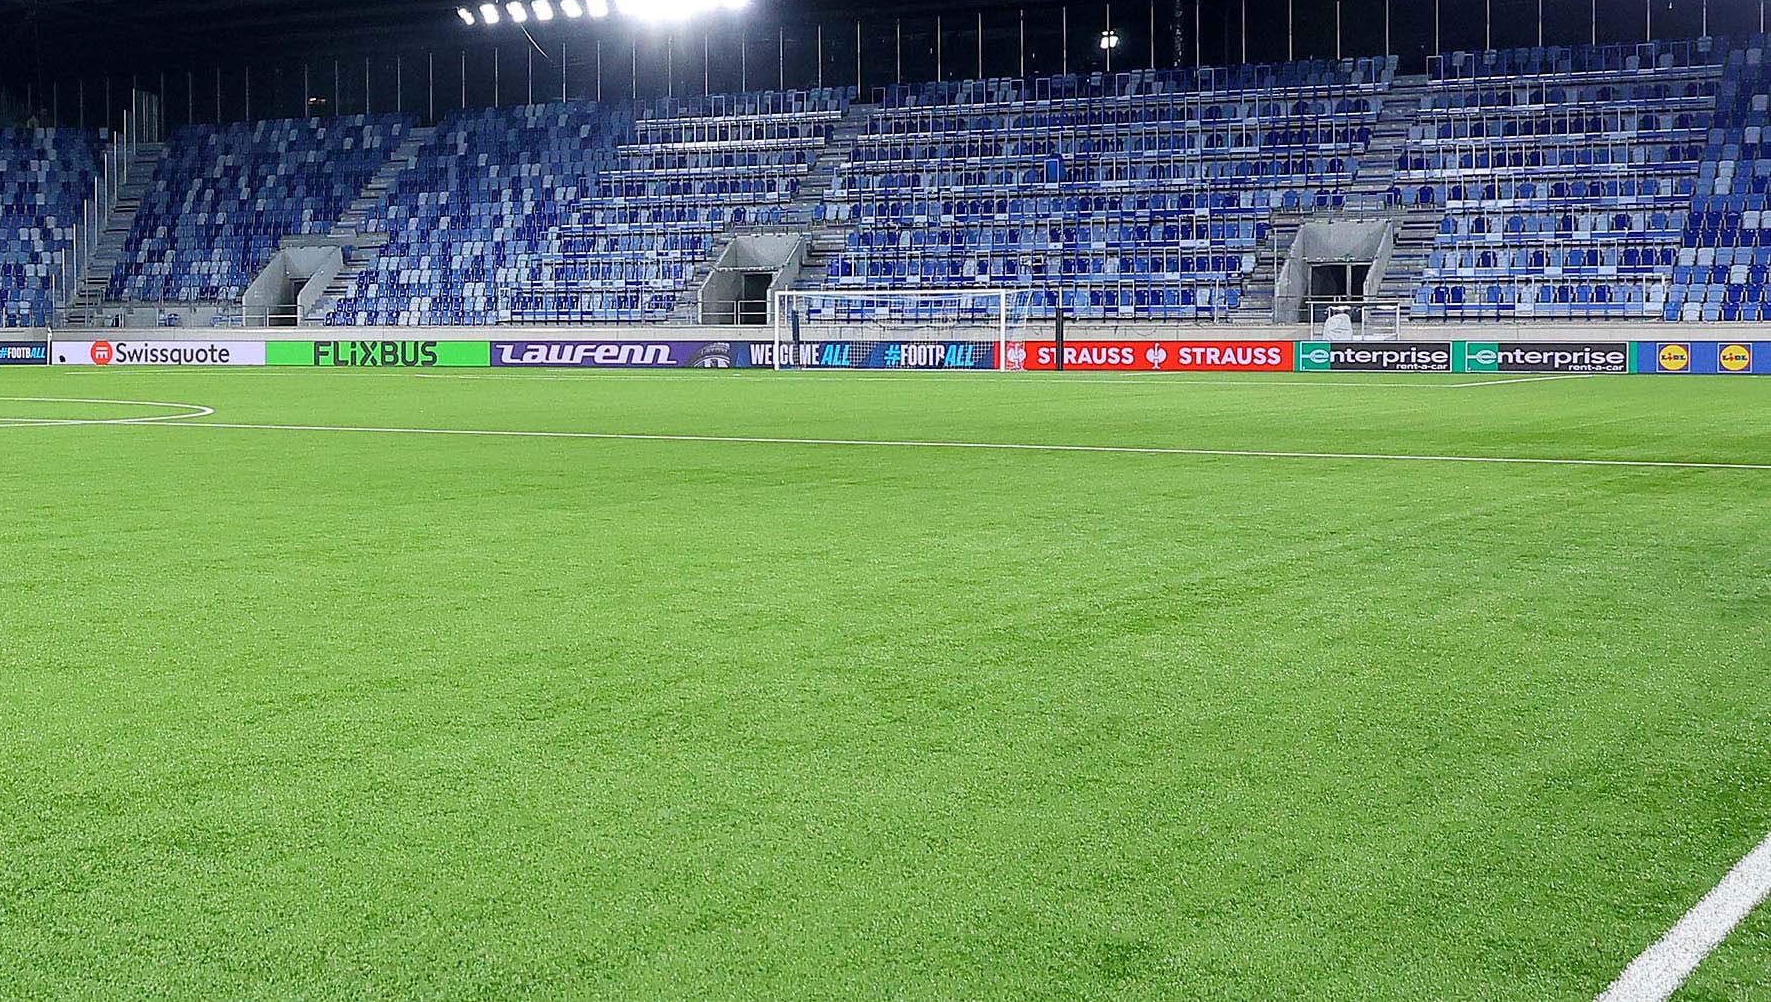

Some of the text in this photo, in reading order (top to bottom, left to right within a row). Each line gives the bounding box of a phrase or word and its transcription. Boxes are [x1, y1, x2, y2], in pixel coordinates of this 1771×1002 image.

[115, 342, 230, 364] Swissquote
[821, 344, 850, 365] ALL
[1179, 347, 1281, 365] STRAUSS
[1309, 348, 1449, 366] enterprise
[1476, 348, 1625, 368] enterprise
